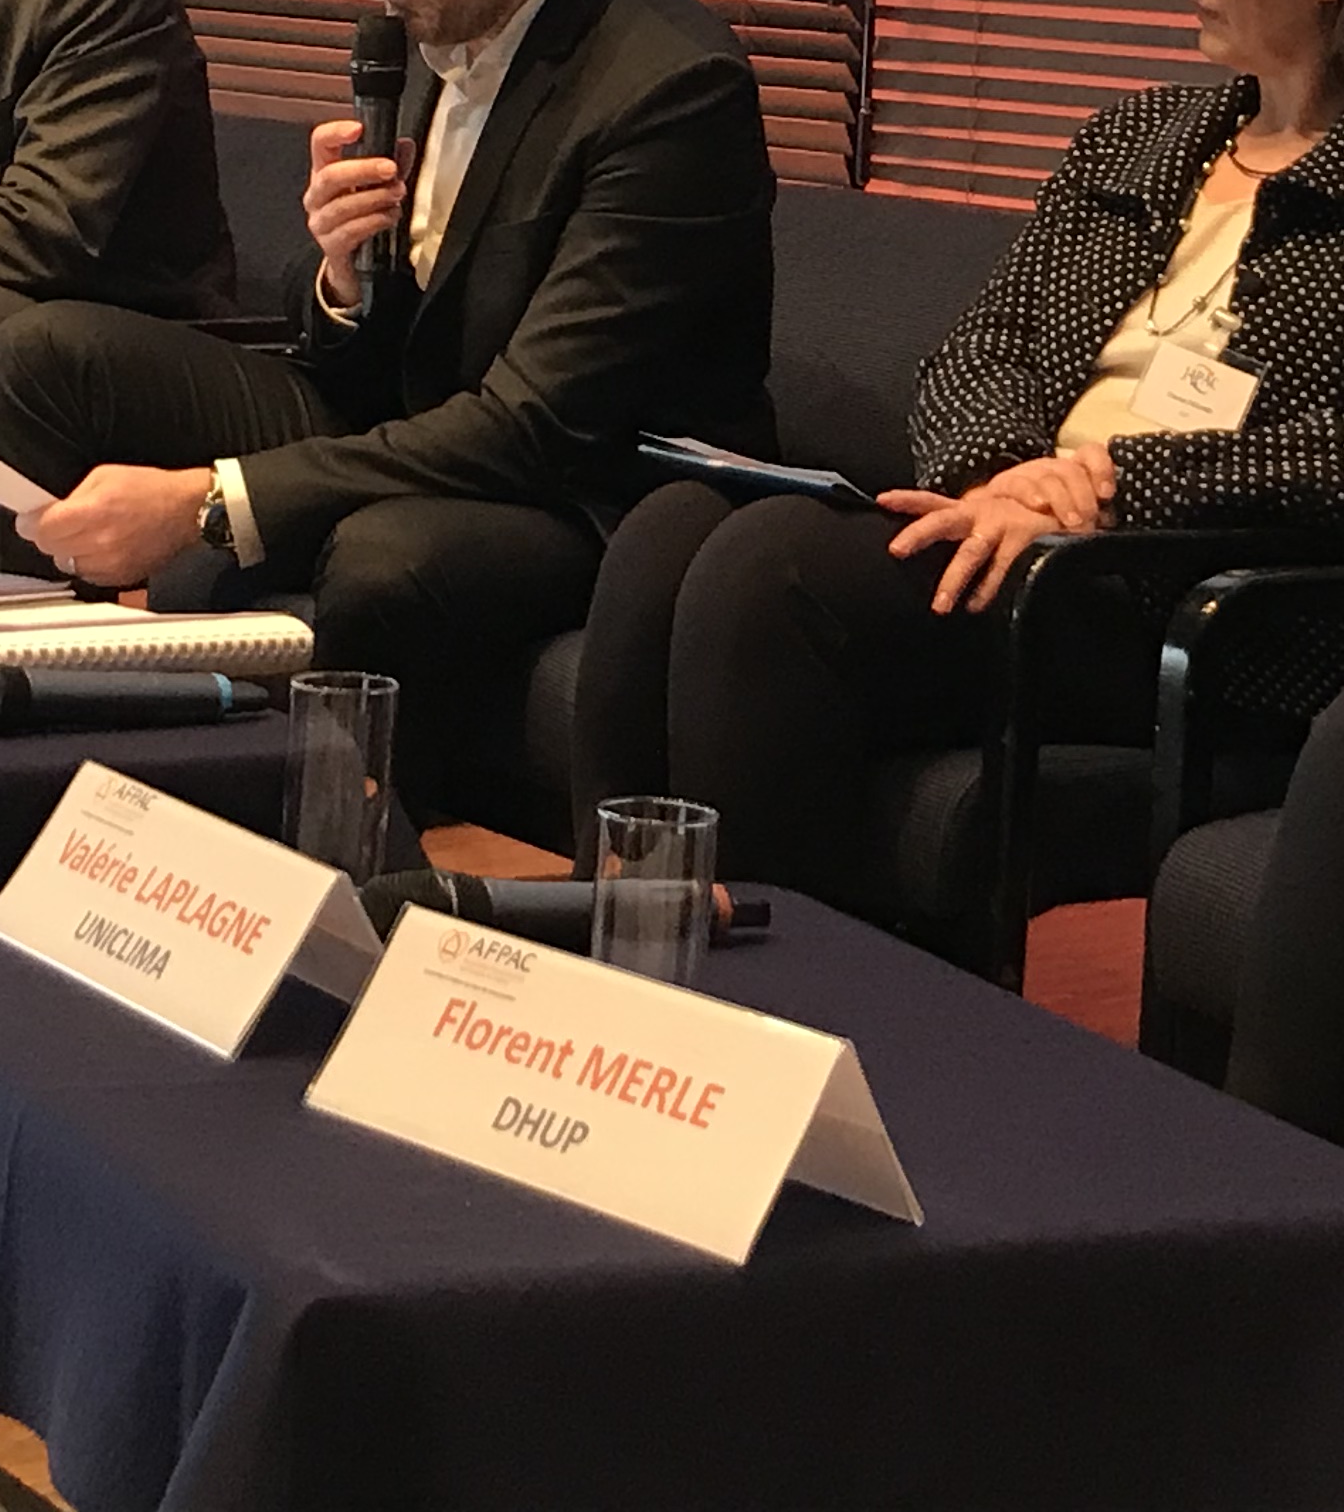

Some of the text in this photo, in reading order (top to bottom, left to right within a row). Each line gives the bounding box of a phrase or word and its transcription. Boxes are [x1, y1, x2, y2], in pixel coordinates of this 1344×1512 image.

[114, 782, 158, 812] AFPAC
[59, 828, 272, 956] Valérie LAPLAGNE
[74, 910, 172, 981] UNICLIMA
[468, 937, 537, 973] AFPAC
[432, 997, 725, 1129] Florent MERLE
[491, 1096, 590, 1154] DHUP
